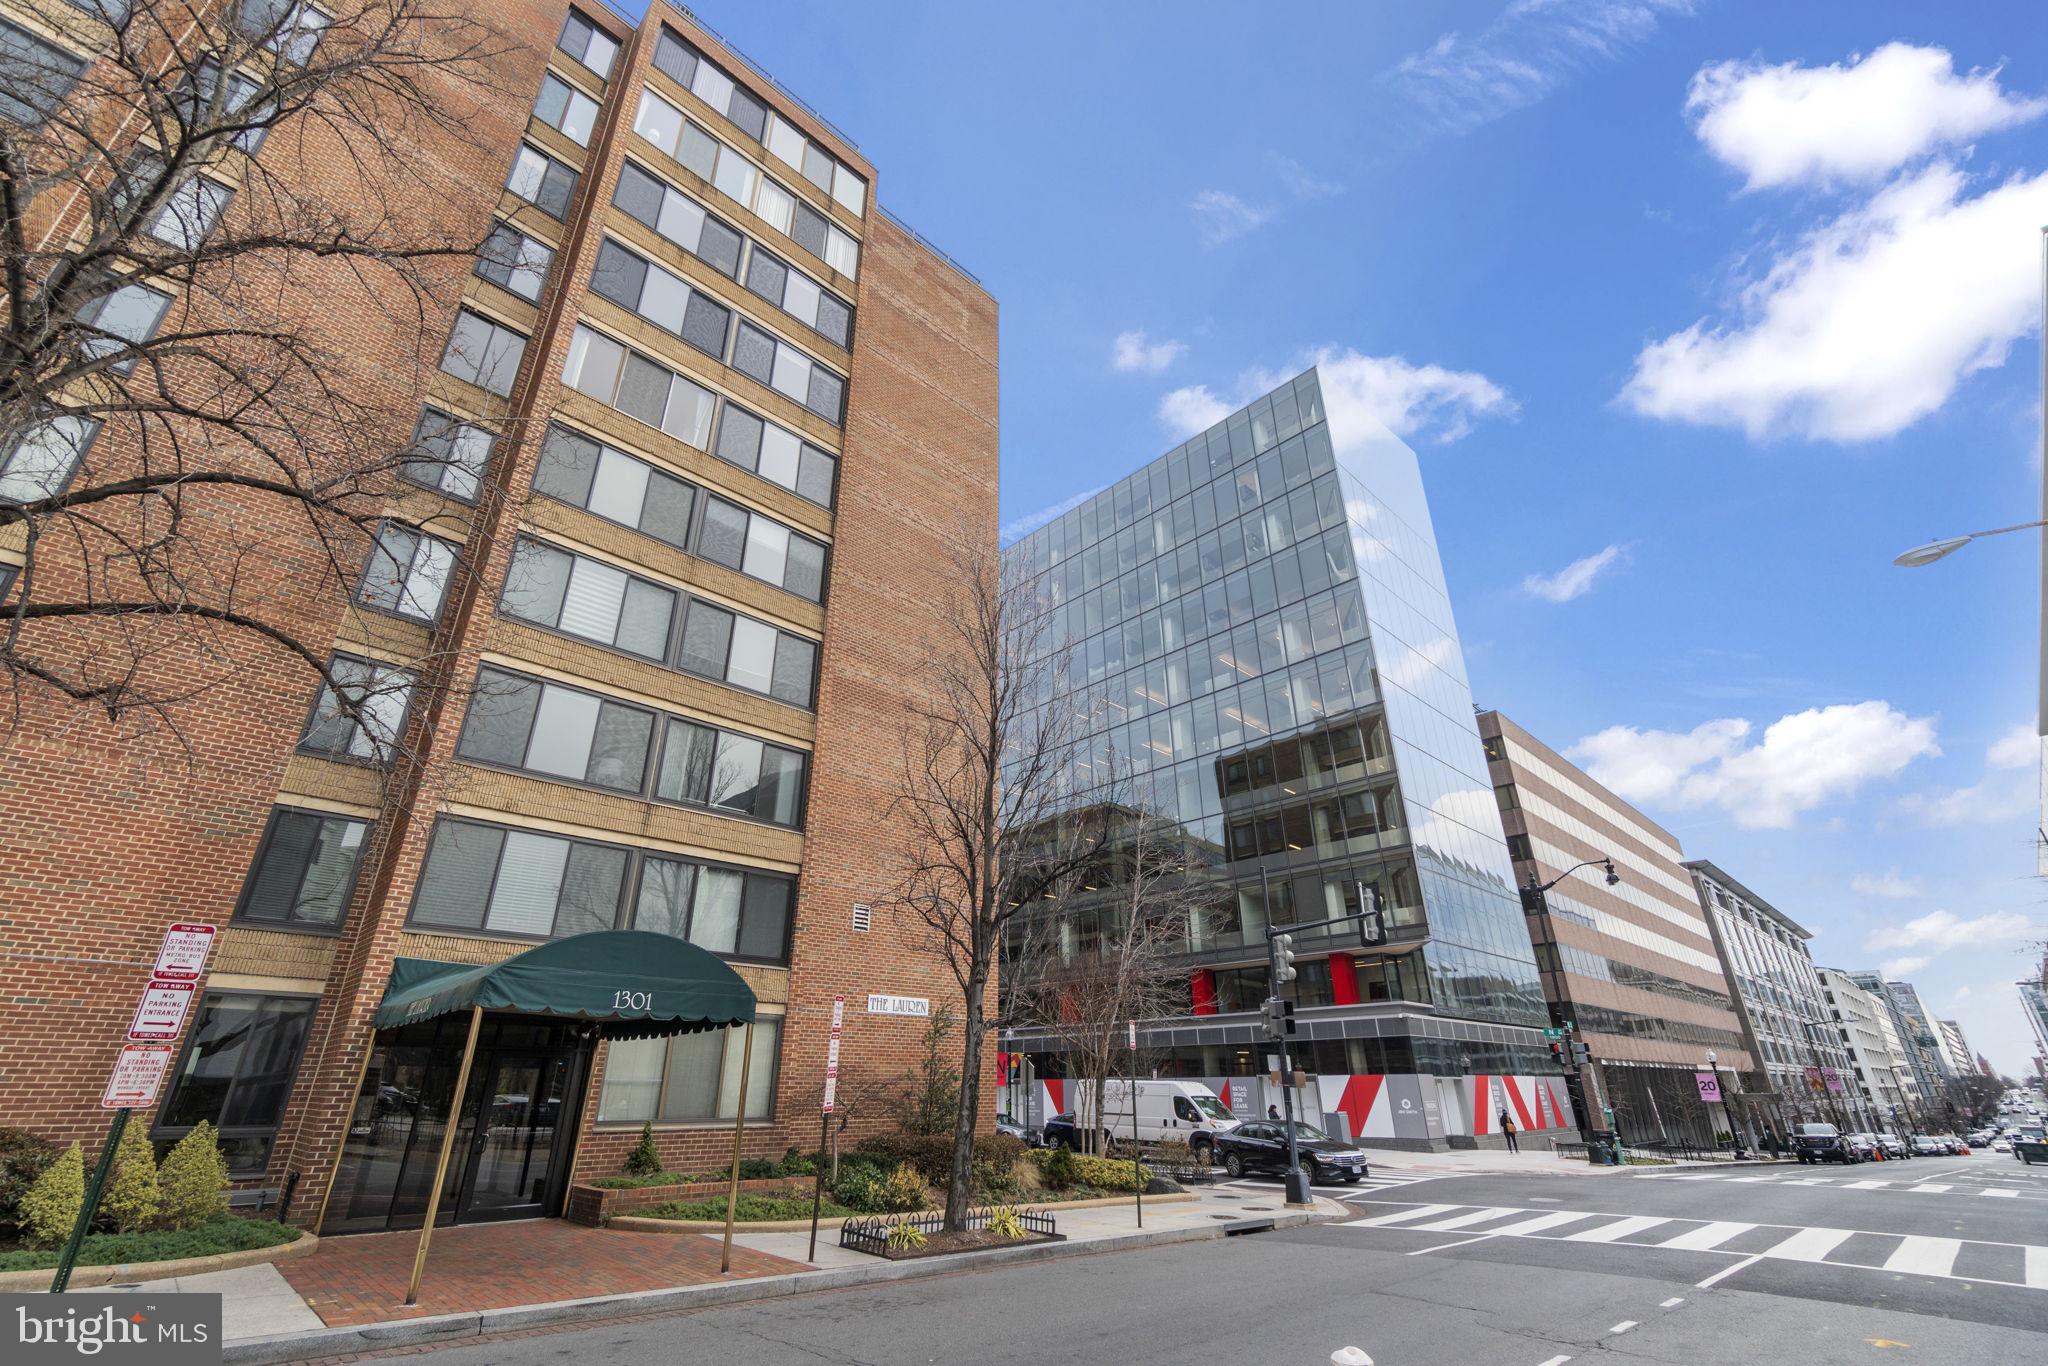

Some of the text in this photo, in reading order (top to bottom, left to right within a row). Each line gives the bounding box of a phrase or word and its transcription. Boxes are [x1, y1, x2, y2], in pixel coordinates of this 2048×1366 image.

[169, 938, 207, 946] STANDING
[612, 990, 652, 1011] 1301
[870, 997, 927, 1014] THE LAUREN
[143, 1009, 180, 1017] ENTRANCE
[1699, 1080, 1716, 1091] 20
